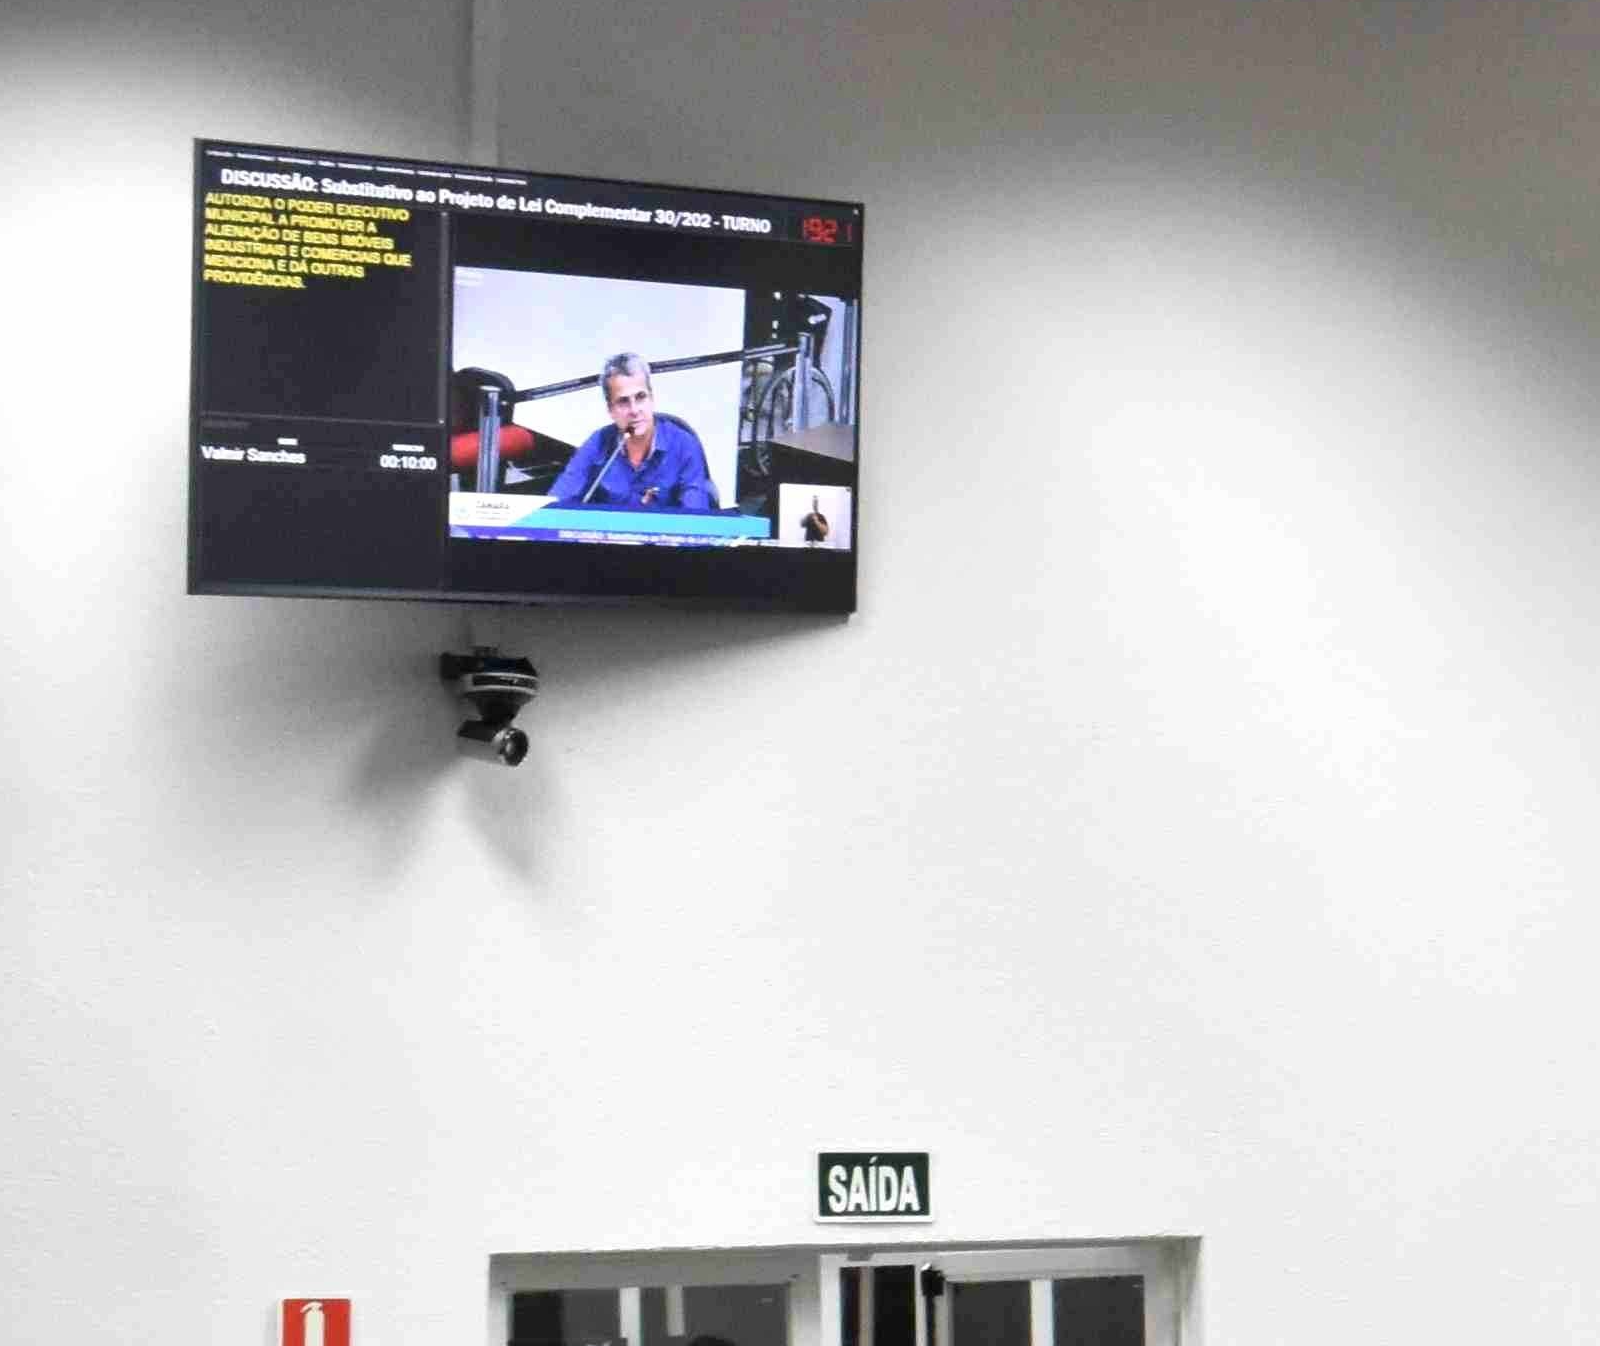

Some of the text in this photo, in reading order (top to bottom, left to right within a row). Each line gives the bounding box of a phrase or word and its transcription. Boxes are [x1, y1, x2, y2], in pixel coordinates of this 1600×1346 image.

[205, 193, 409, 221] AUTORIZA O PODER EXECUTIVO
[221, 169, 318, 192] DISCUSSÃO:
[416, 190, 436, 203] ao
[439, 190, 494, 208] Projeto
[496, 196, 516, 210] de
[519, 197, 542, 212] Lei
[545, 199, 652, 222] Complementar
[655, 210, 711, 228] 30/202
[722, 215, 771, 233] TURNO
[205, 208, 377, 233] MUNICIPAL A PROMOVER A
[205, 223, 394, 250] ALIENAÇÃO DE BENS IMÓVEIS
[204, 254, 364, 277] MENCIONA E DÁ OUTRAS
[205, 239, 411, 266] INDUSTRIAIS E COMERCIAIS QUE
[828, 1157, 920, 1213] SAÍDA
